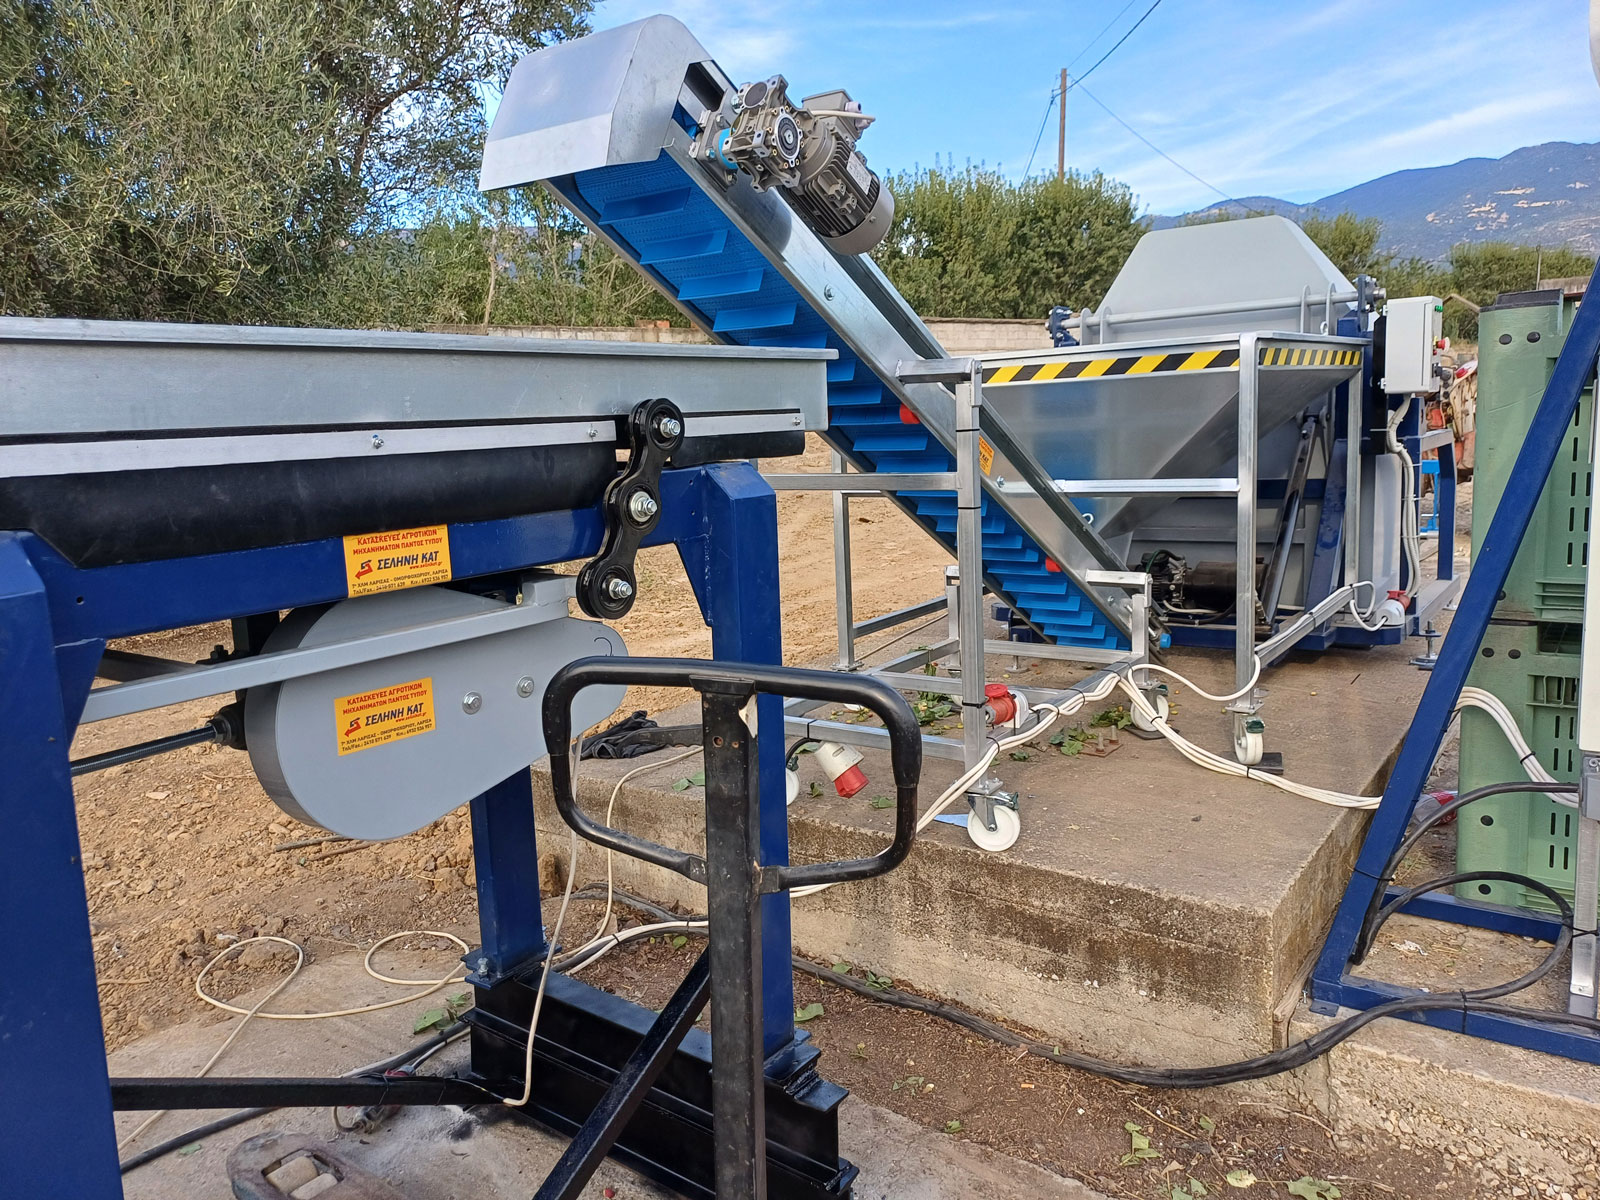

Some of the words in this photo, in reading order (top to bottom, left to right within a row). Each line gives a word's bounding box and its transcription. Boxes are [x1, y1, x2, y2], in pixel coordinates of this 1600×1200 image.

[358, 534, 400, 545] ΚΑΤΑΣΚΕΥΕΣ
[402, 529, 437, 539] ΑΓΡΟΤΙΚΩΝ
[353, 543, 400, 555] ΜΗΧΑΝΗΜΑΤΩΝ
[401, 540, 424, 548] ΠΑΝΤΟΣ
[377, 554, 419, 570] ΣΕΛΗΝΗ
[421, 551, 440, 563] ΚΑΤ
[343, 700, 387, 715] ΜΗΧΑΝΗΜΑΤΩΝ
[388, 694, 409, 704] ΠΑΝΤΟΣ
[411, 690, 427, 698] ΤΥΠΟΥ
[347, 691, 387, 705] ΚΑΤΑΣΚΕΥΕΣ
[389, 683, 422, 695] ΑΓΡΟΤΙΚΩΝ
[365, 707, 405, 726] ΣΕΛΗΝΗ
[406, 702, 424, 716] ΚΑΤ
